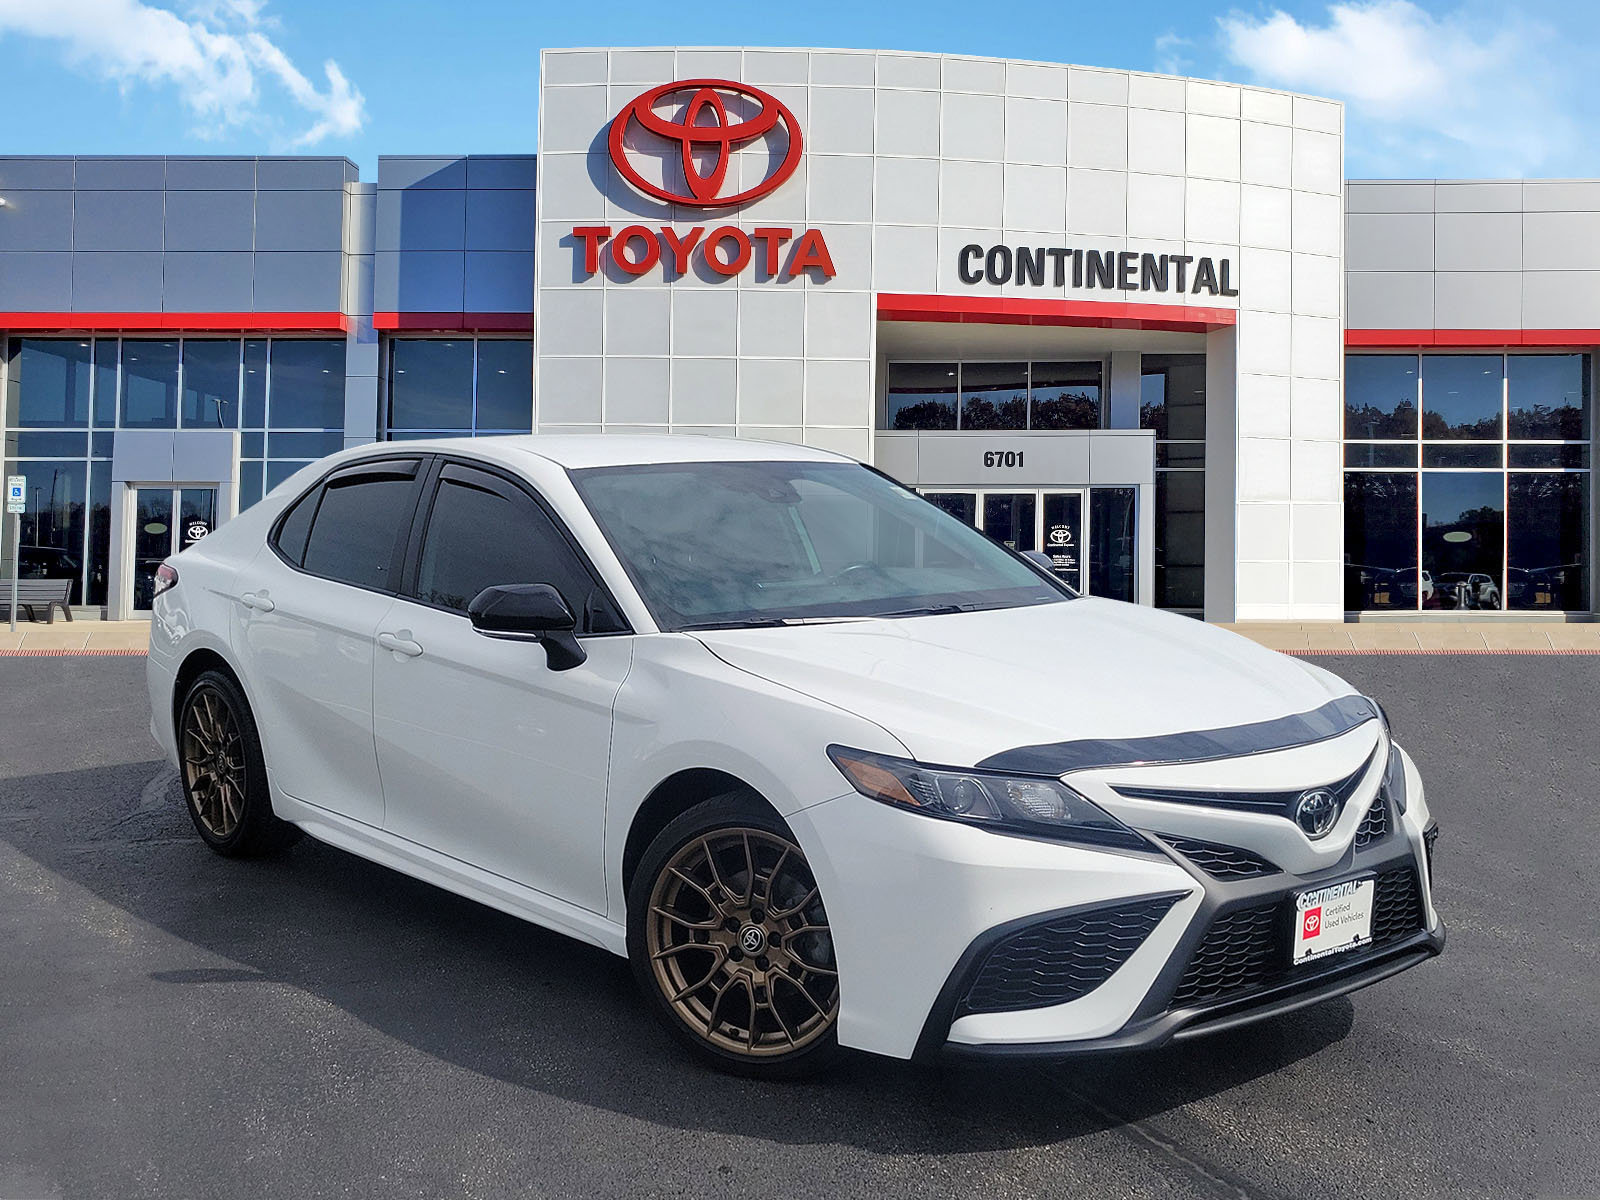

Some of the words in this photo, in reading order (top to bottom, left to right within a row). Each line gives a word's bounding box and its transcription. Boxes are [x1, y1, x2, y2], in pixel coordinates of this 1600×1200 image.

[573, 225, 836, 278] TOYOTA
[958, 243, 1239, 297] CONTINENTAL
[983, 451, 1024, 468] 6701
[1324, 919, 1340, 929] Used
[1340, 911, 1364, 925] Vehicles
[1325, 903, 1351, 917] Certified
[1293, 937, 1373, 966] ContinentalToyota.com
